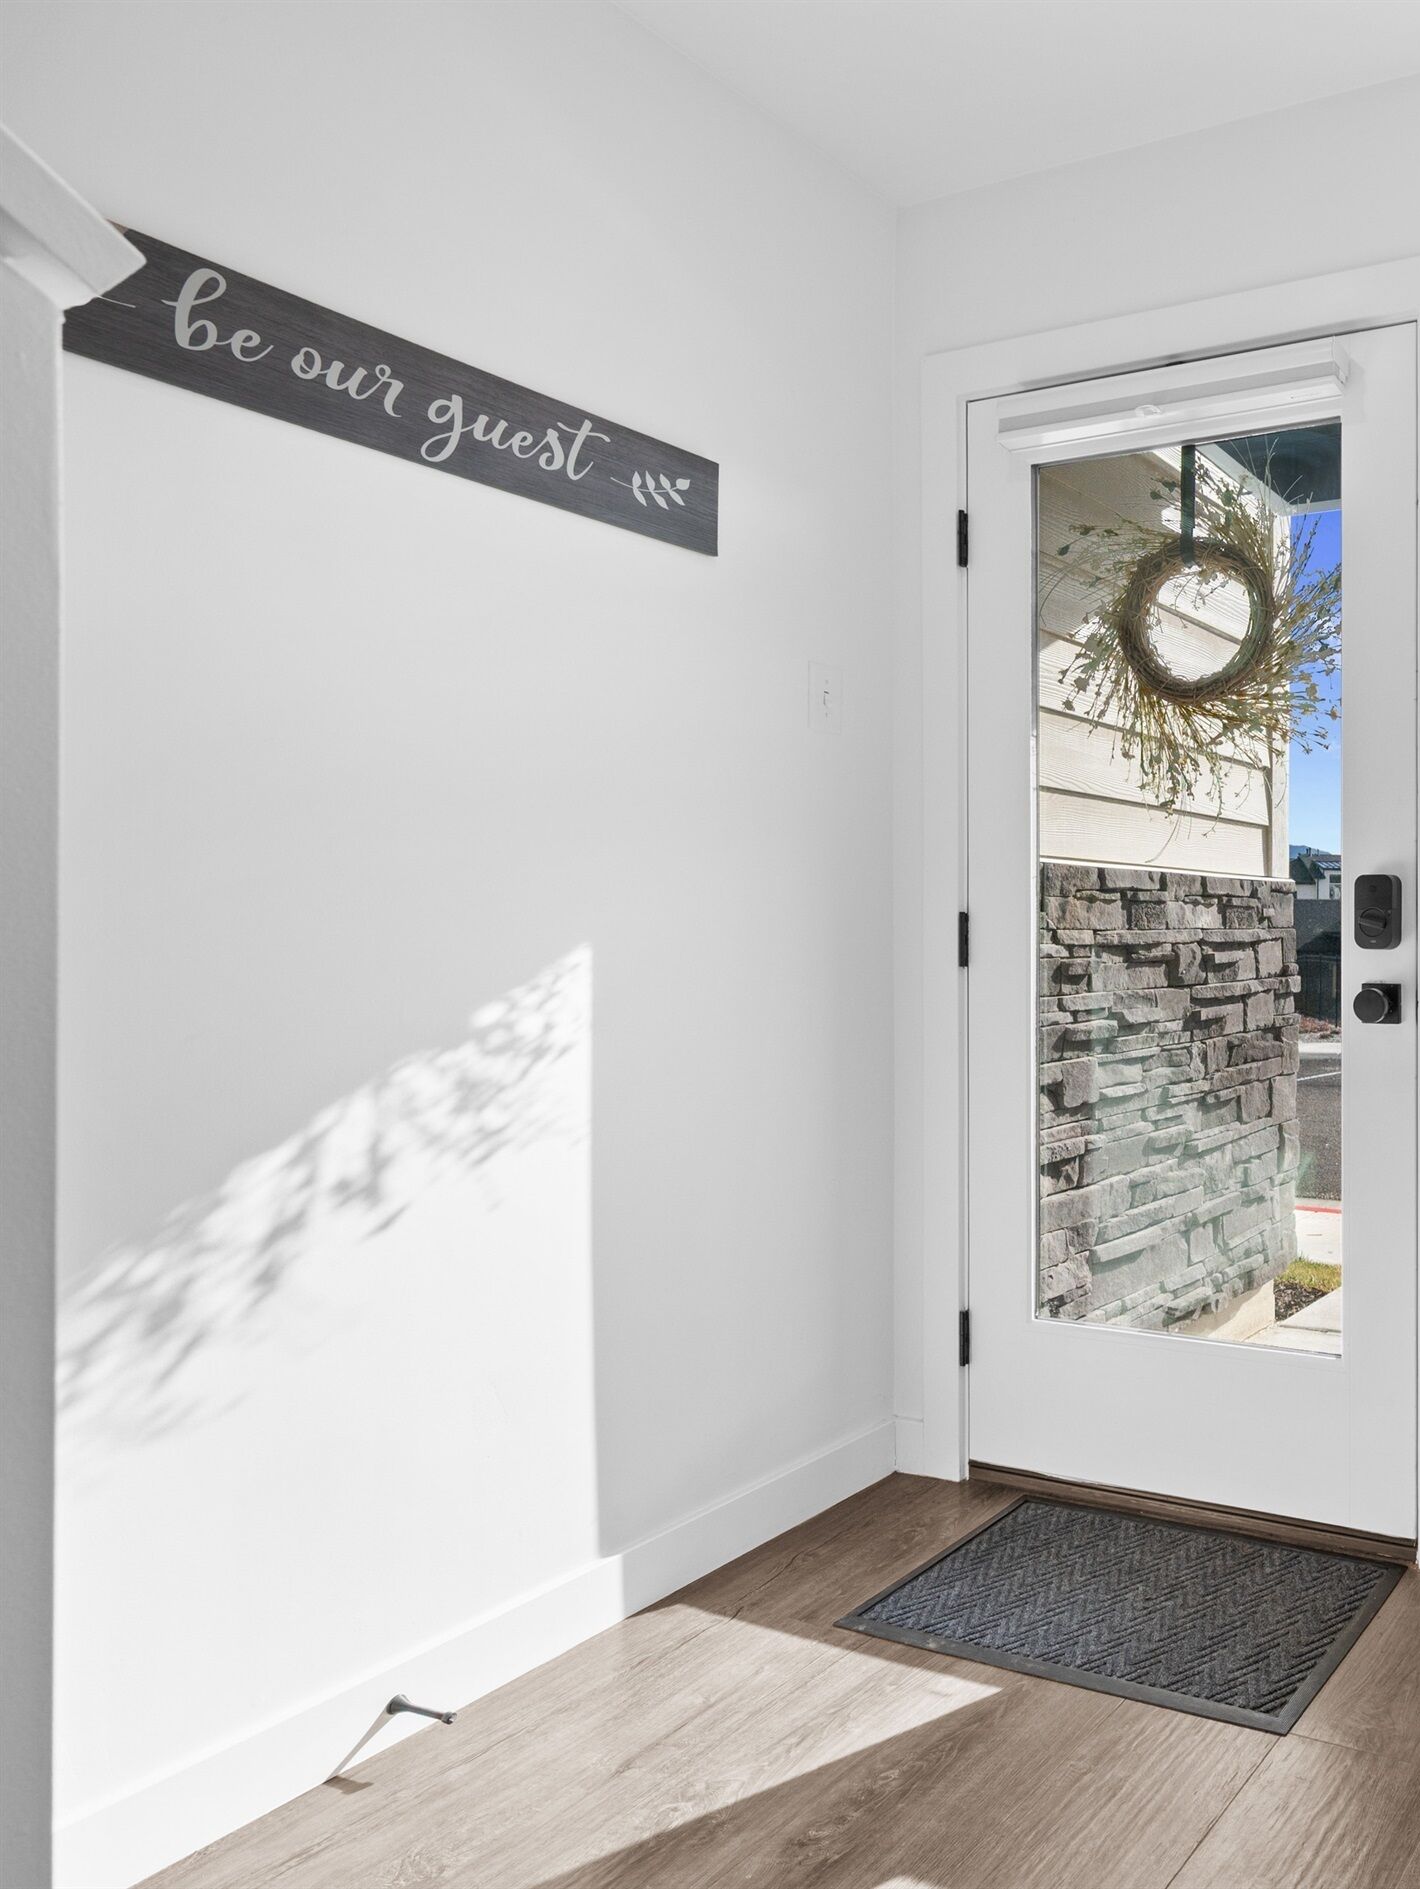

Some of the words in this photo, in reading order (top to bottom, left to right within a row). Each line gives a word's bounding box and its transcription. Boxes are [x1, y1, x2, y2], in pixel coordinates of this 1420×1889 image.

[161, 267, 274, 362] be
[290, 346, 405, 418] our
[420, 393, 612, 481] guest
